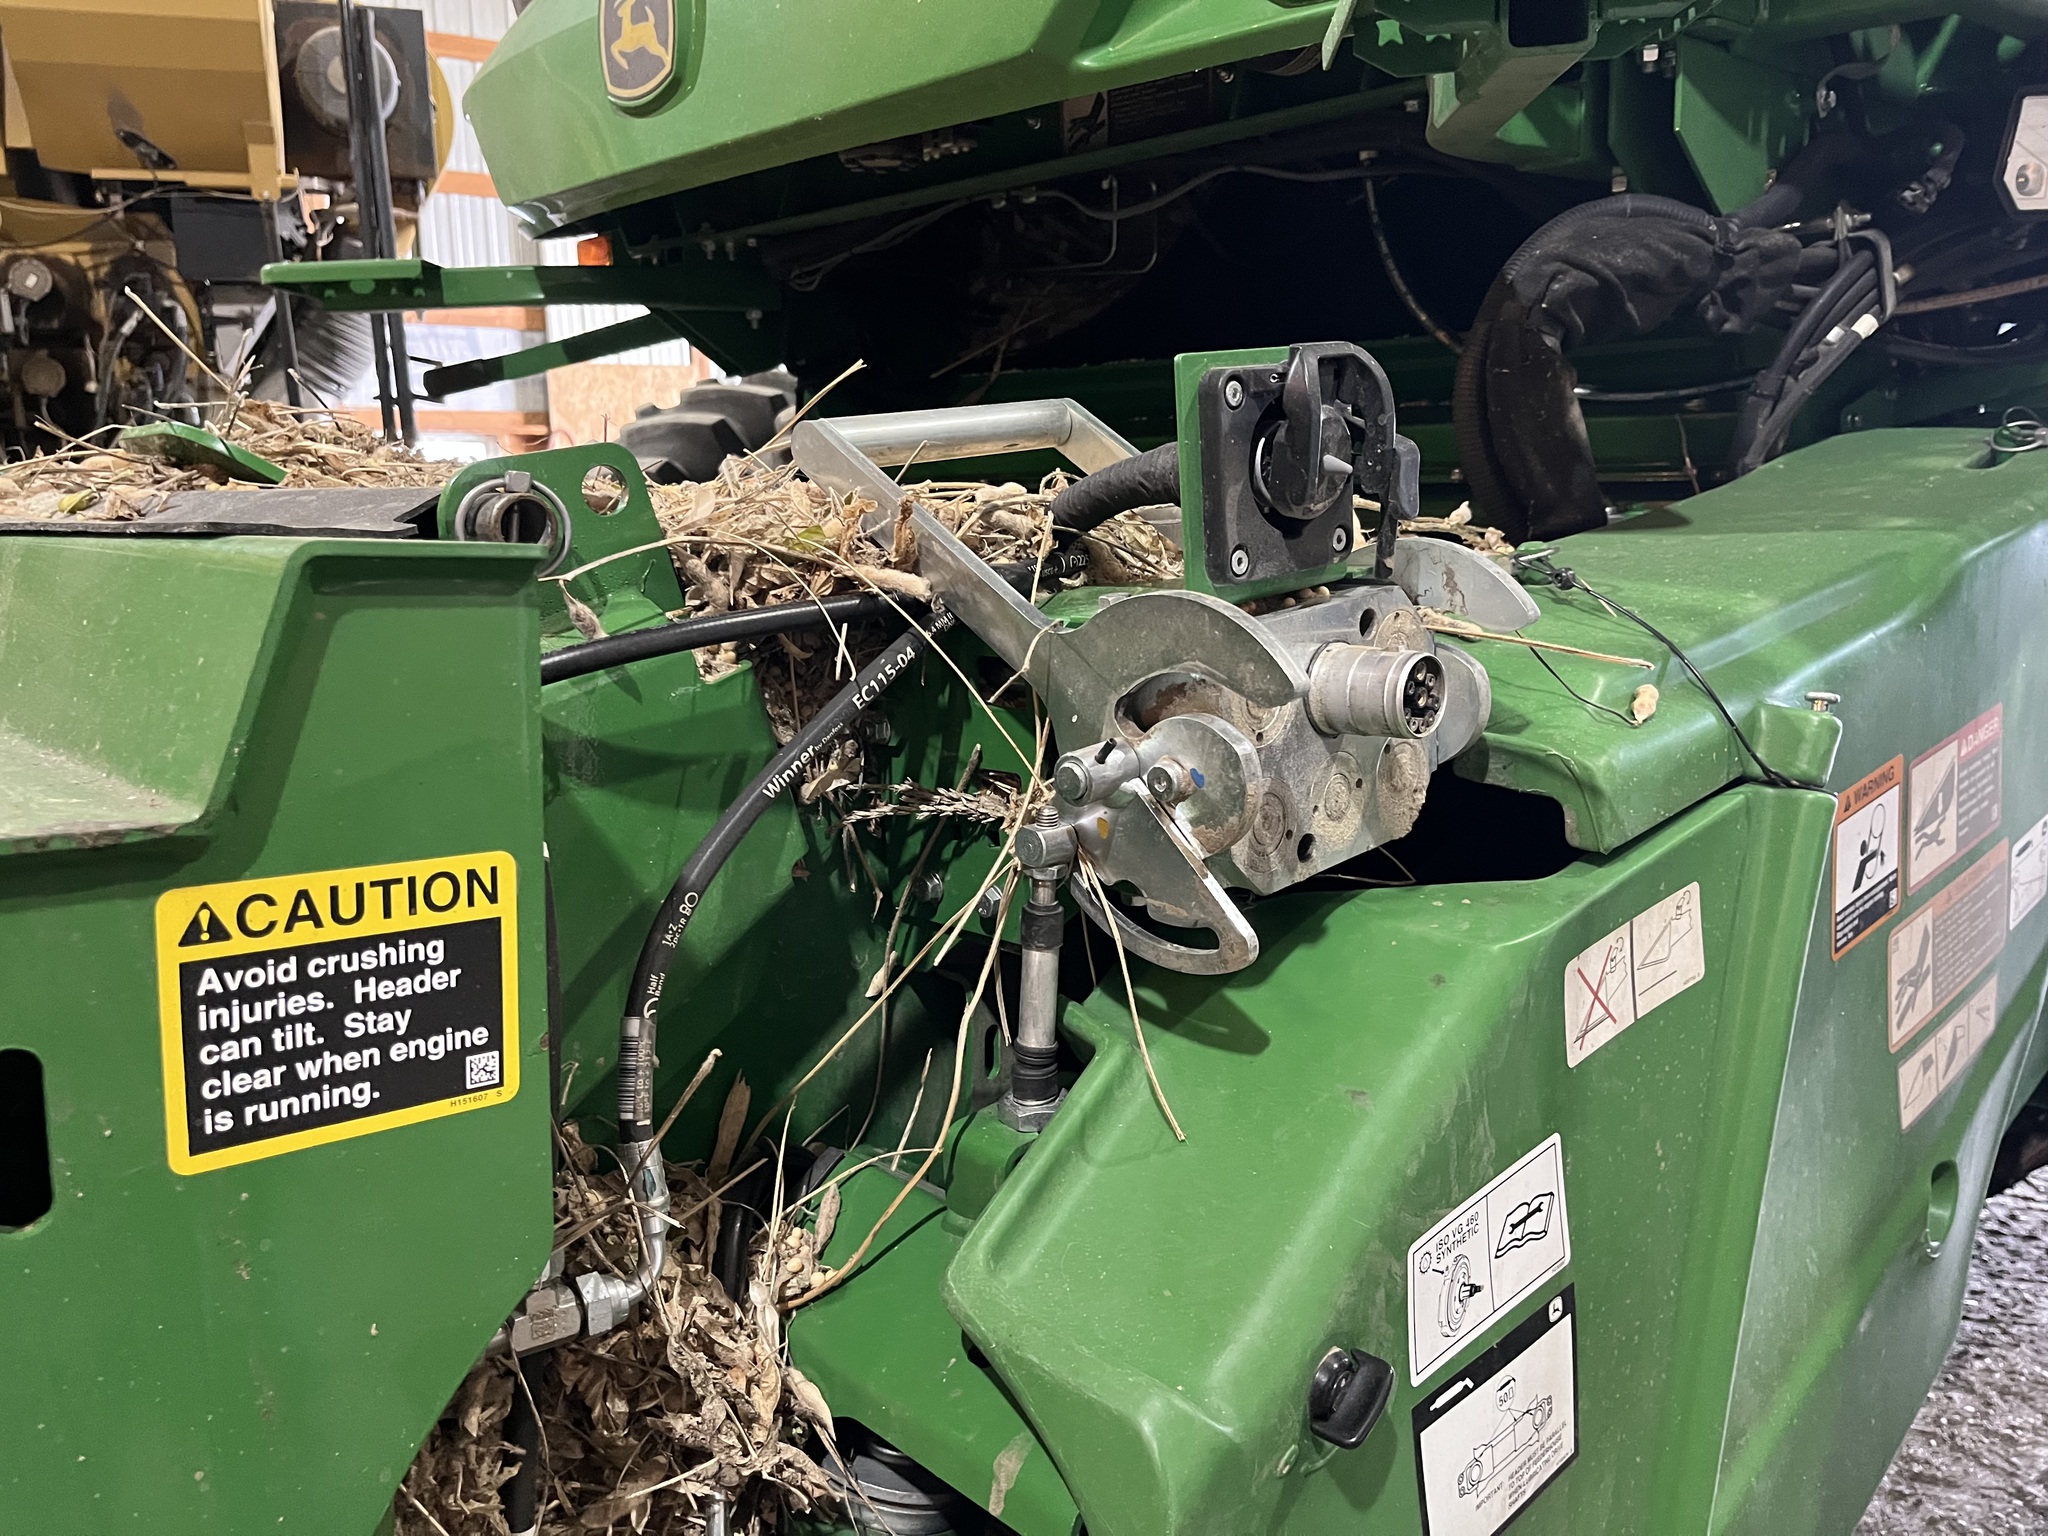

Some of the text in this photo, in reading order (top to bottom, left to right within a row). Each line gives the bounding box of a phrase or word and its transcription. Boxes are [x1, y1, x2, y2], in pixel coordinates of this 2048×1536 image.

[851, 645, 917, 711] EC115-04
[761, 744, 816, 800] Winner
[821, 722, 845, 745] Danfoss
[1853, 765, 1895, 805] WARNING
[236, 865, 499, 939] CAUTION
[196, 938, 445, 997] Avoid crushing
[646, 973, 660, 996] Half
[198, 968, 462, 1033] injuries. Header
[199, 1008, 412, 1066] can tilt. Stay
[201, 1025, 490, 1100] clear when engine
[203, 1080, 381, 1135] is running.
[449, 1093, 489, 1108] H151607
[1434, 1211, 1479, 1252] ISO VG 460
[1435, 1223, 1480, 1265] SYNTHETIC
